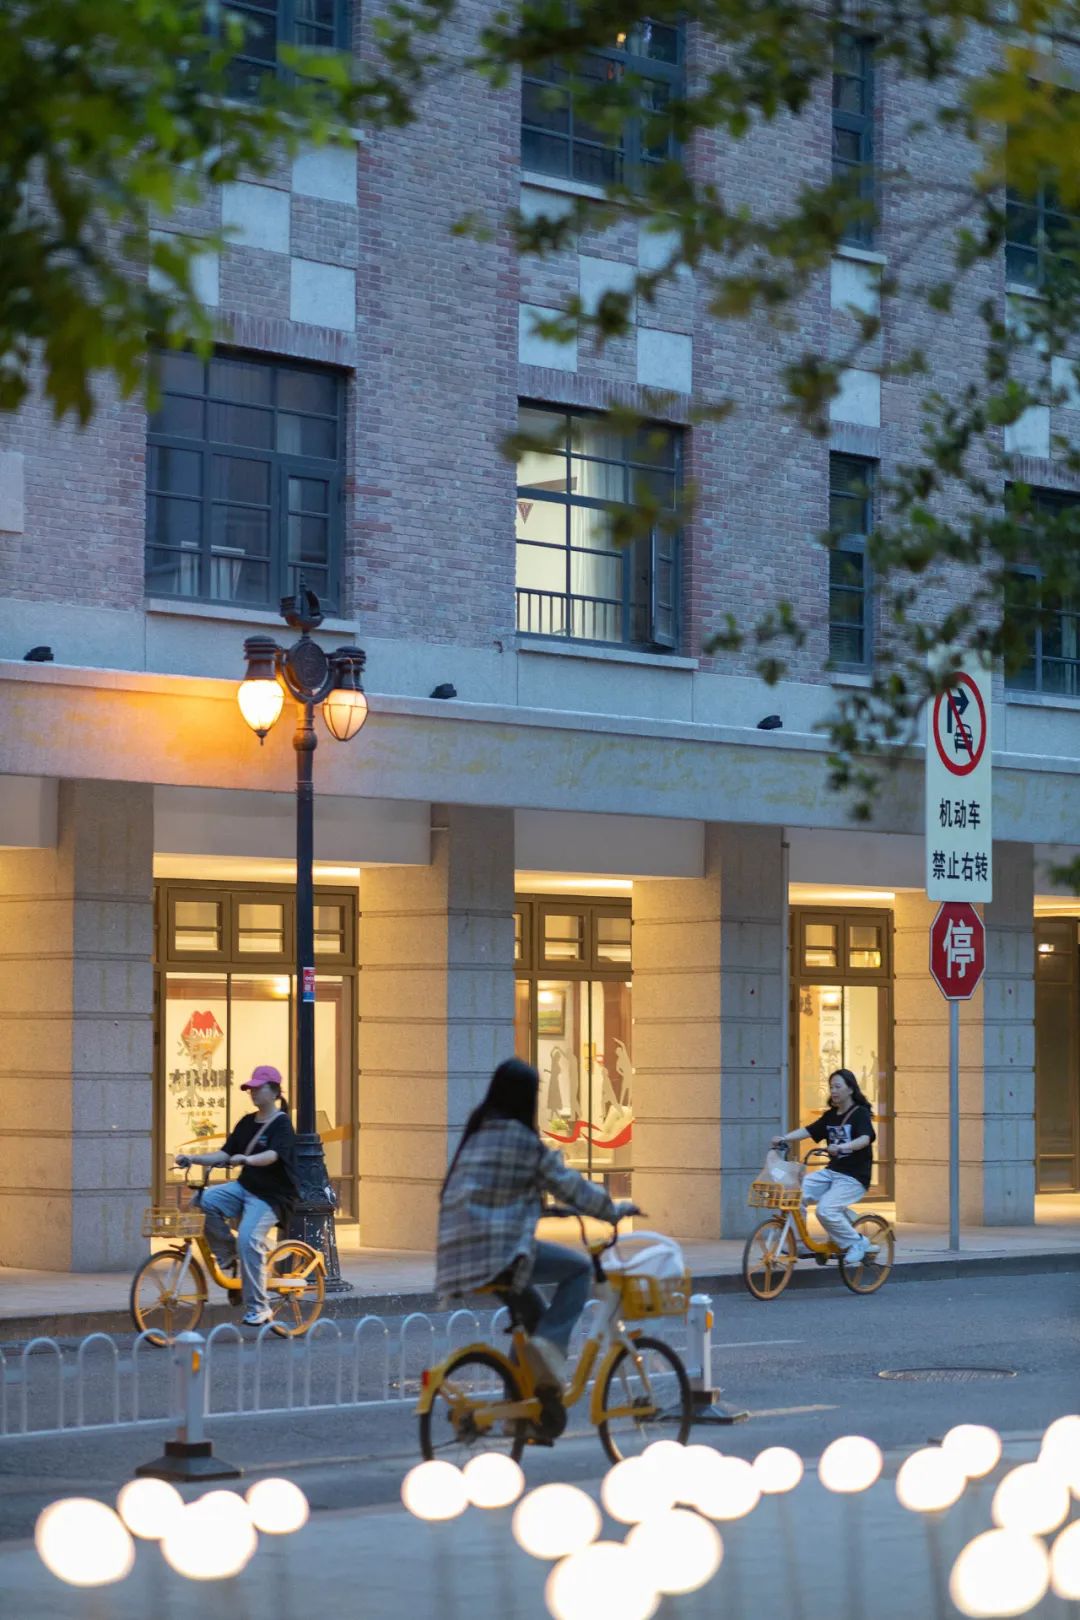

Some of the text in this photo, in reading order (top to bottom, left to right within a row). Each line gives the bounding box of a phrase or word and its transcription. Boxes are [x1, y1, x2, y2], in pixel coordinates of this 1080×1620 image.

[939, 798, 981, 830] 机动车
[932, 850, 988, 881] 禁止右转
[942, 918, 975, 979] 停
